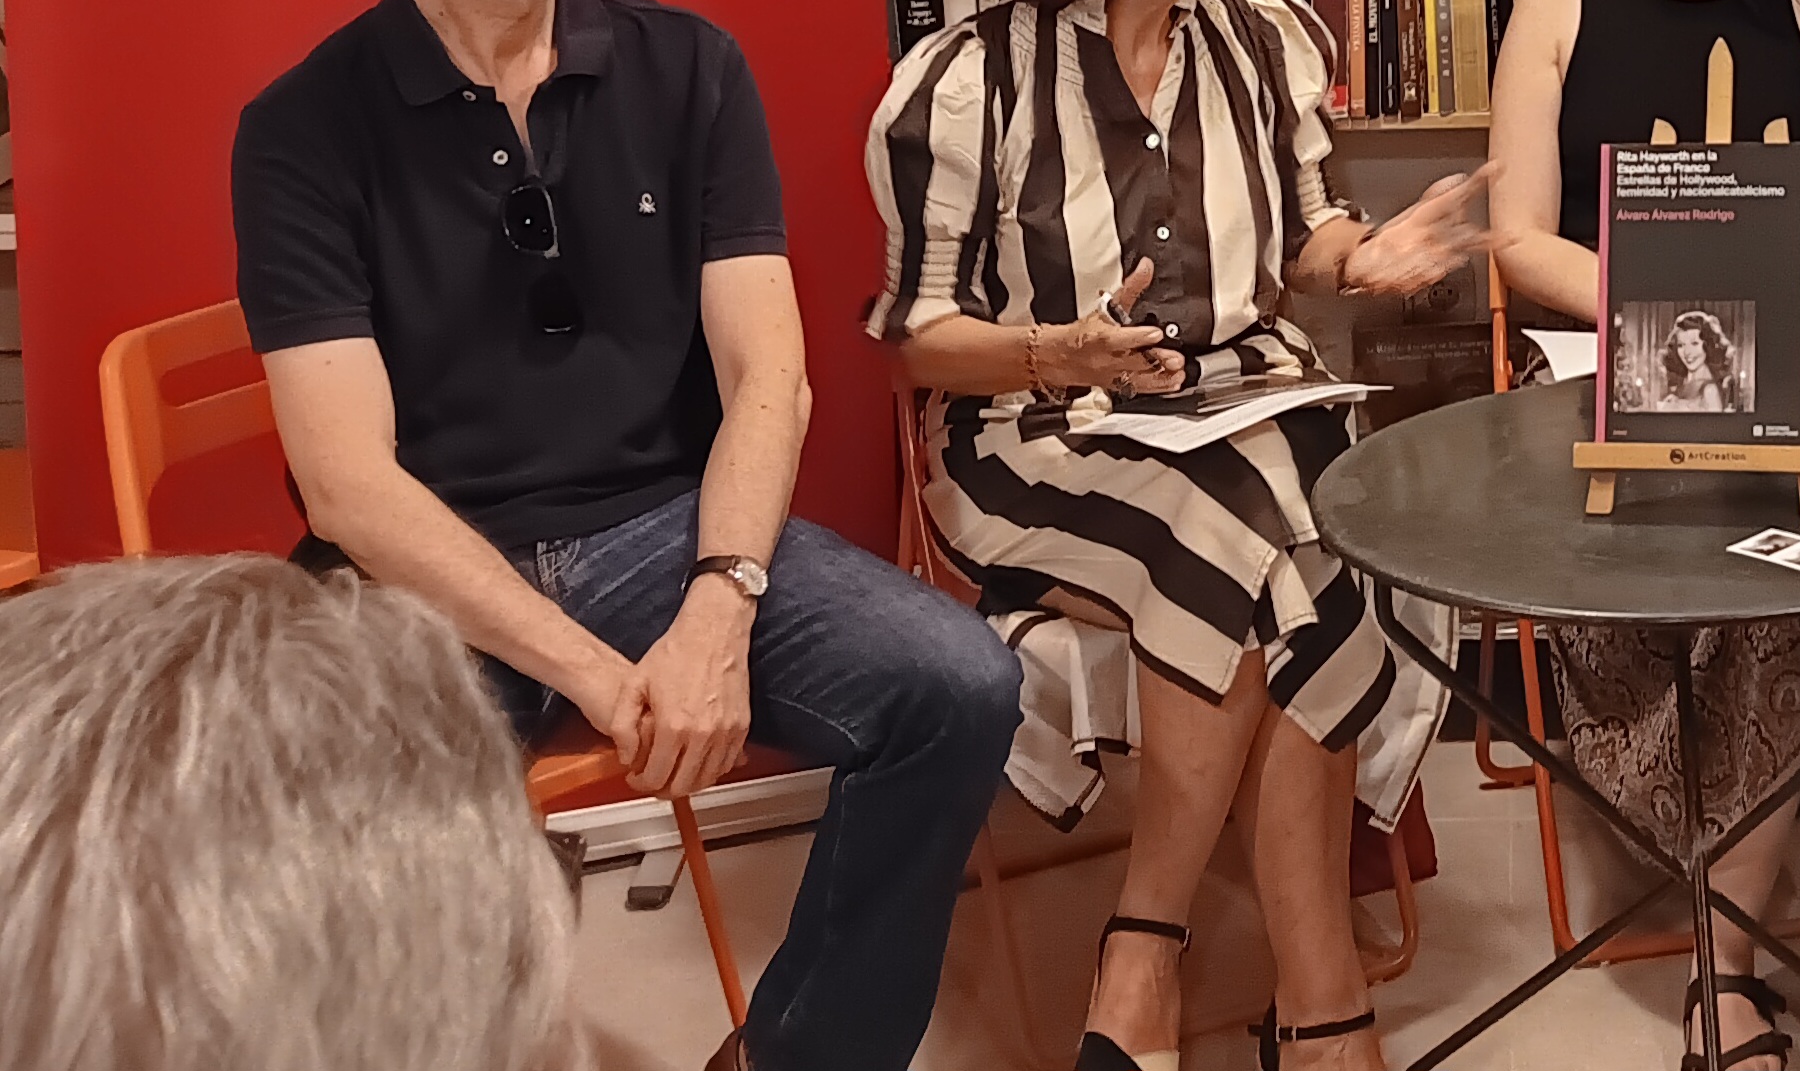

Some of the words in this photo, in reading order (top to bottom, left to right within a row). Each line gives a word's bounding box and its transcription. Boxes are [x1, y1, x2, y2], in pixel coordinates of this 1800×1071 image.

[1366, 28, 1378, 43] EL
[1439, 35, 1450, 76] arte
[1617, 151, 1638, 162] Rita
[1639, 151, 1691, 164] Hayworth
[1691, 154, 1706, 162] en
[1707, 150, 1718, 162] la
[1616, 162, 1656, 175] España
[1657, 163, 1671, 174] de
[1673, 162, 1711, 174] Franco
[1616, 174, 1662, 186] Estrellas
[1663, 174, 1677, 186] de
[1679, 173, 1738, 187] Hollywood,
[1616, 185, 1669, 197] feminidad
[1679, 185, 1786, 197] nacionalcatolicismo
[1616, 208, 1650, 221] Álvaro
[1651, 208, 1691, 221] Álvarez
[1692, 209, 1736, 223] Rodrigo
[1687, 452, 1747, 462] ArtCreation
